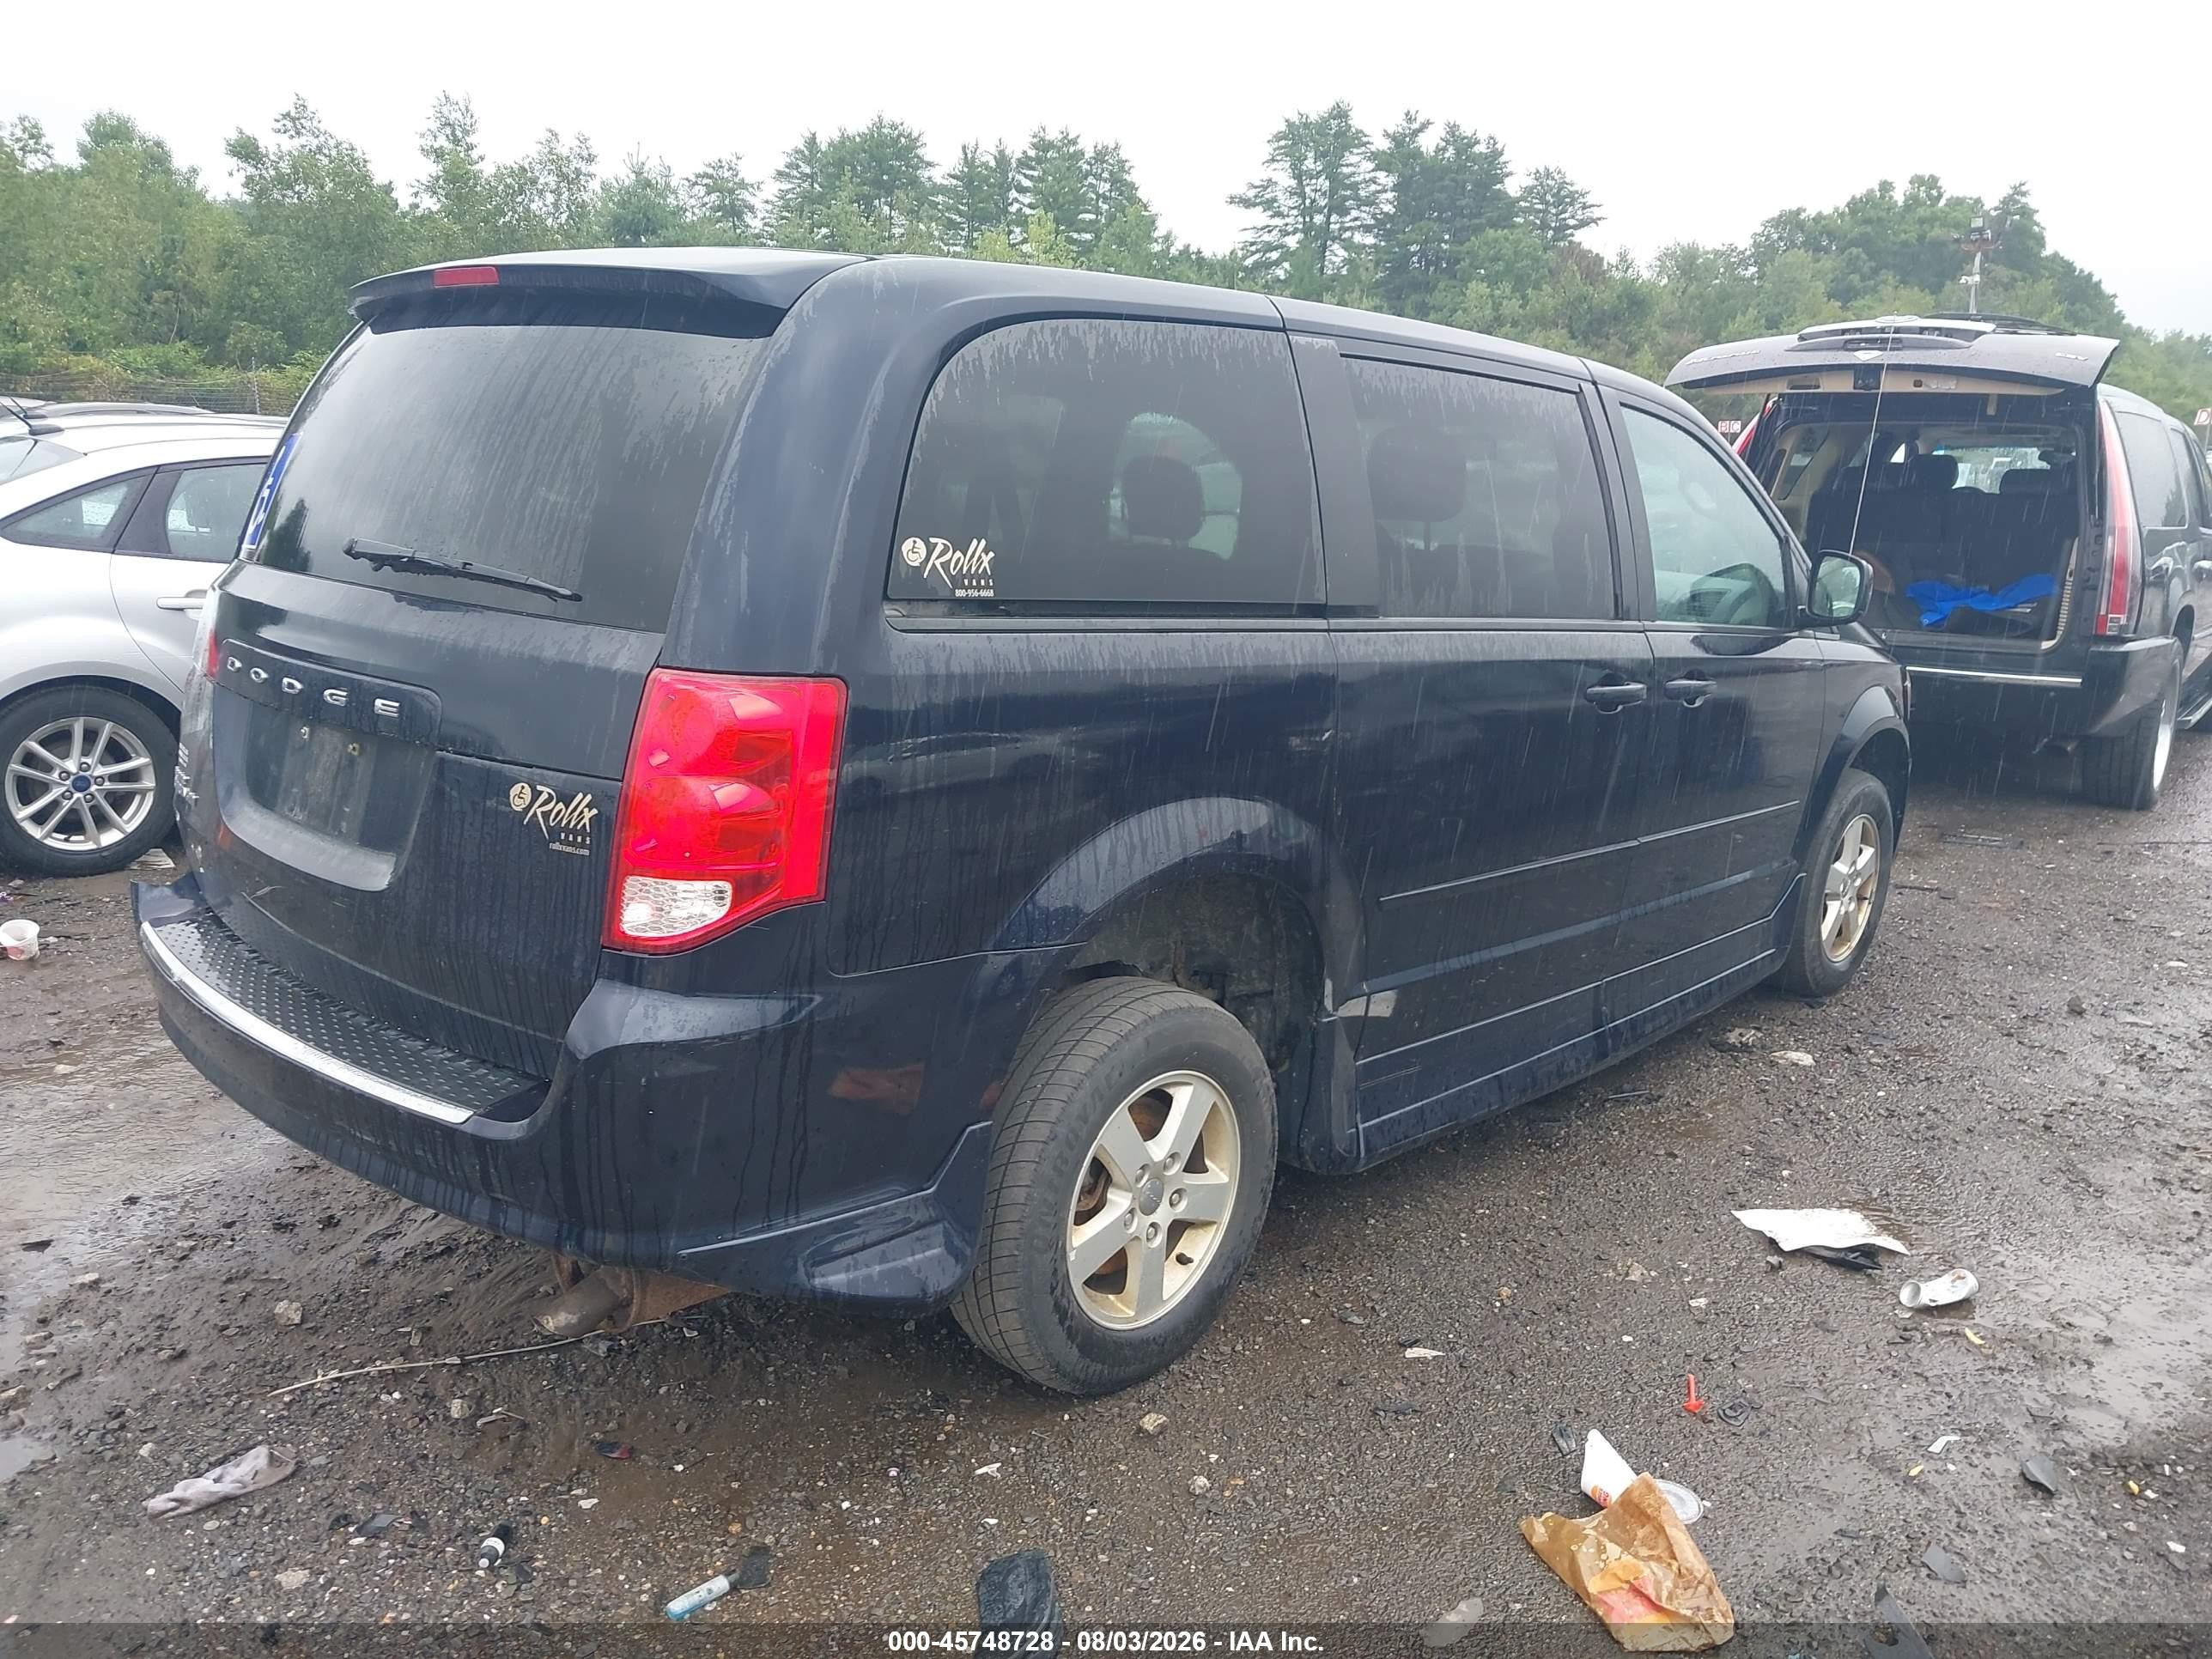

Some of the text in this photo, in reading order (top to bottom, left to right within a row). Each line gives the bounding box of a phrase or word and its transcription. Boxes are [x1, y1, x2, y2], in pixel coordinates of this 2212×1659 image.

[923, 537, 996, 589] Rollx
[963, 578, 994, 586] VANS
[226, 656, 401, 718] DODGE
[523, 784, 599, 841] Rollx
[560, 832, 591, 845] VANS
